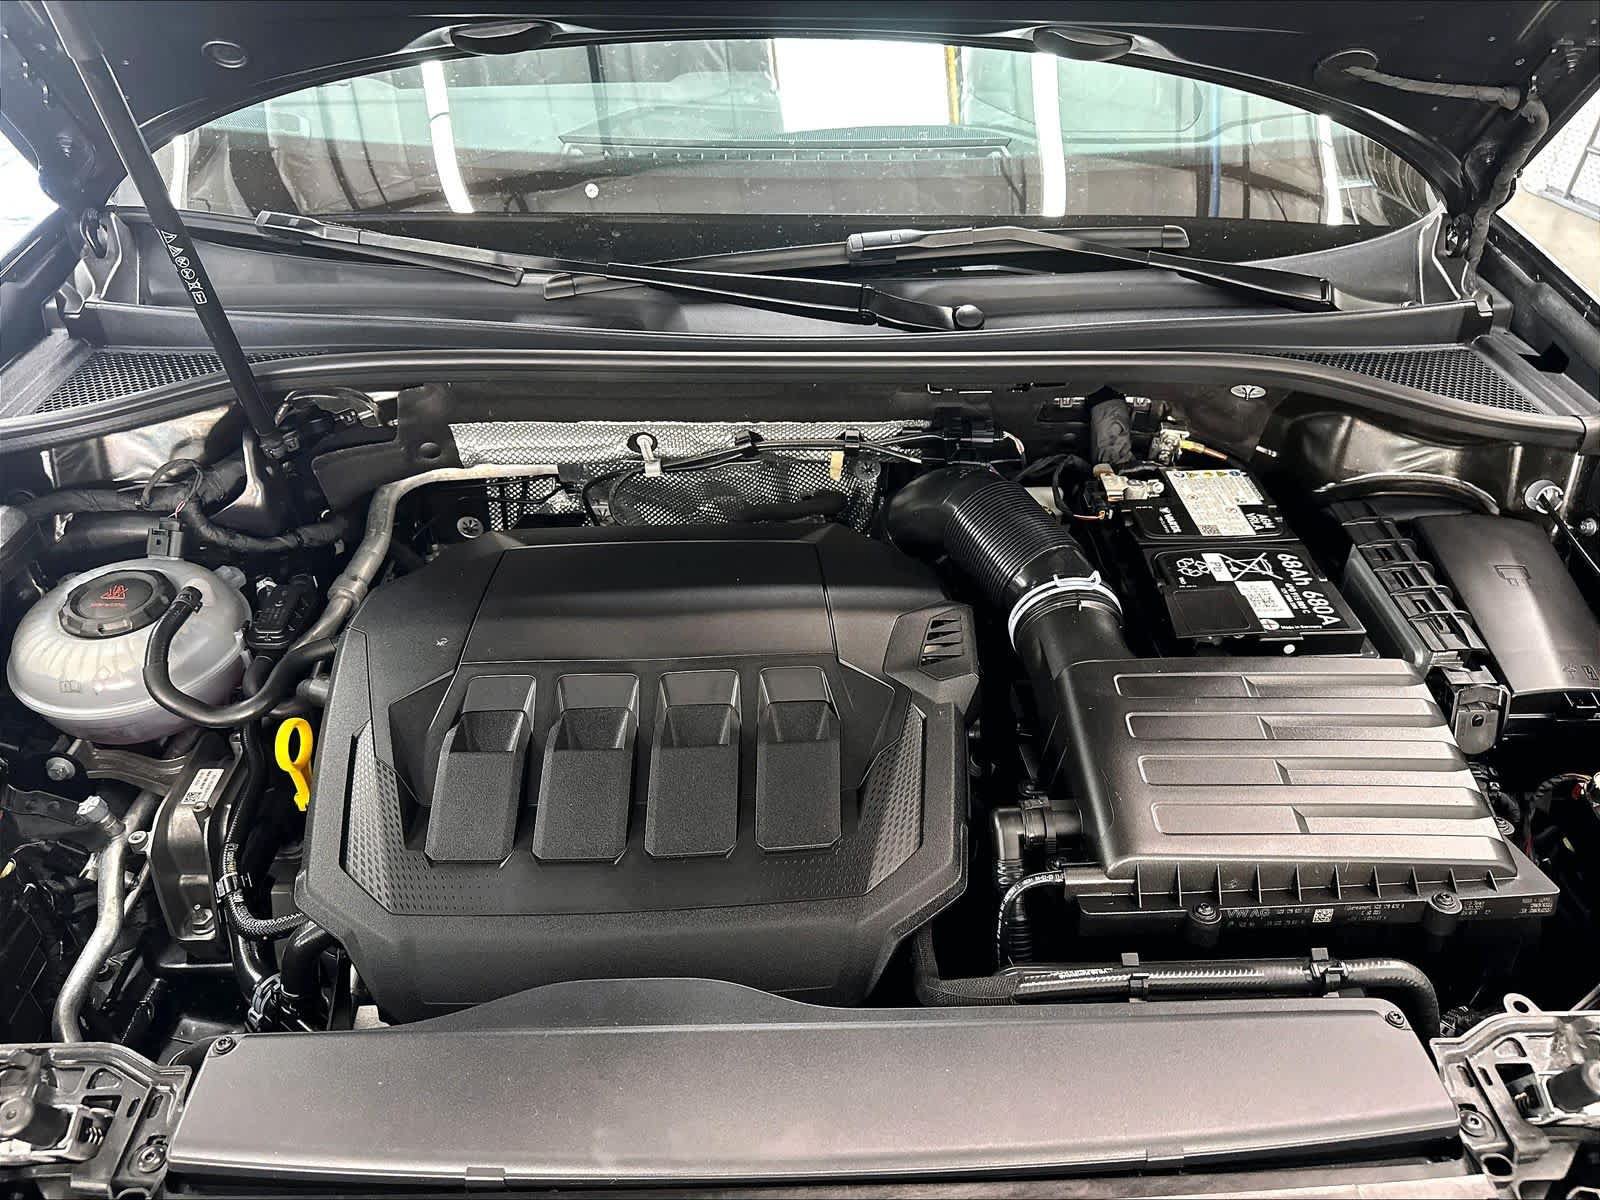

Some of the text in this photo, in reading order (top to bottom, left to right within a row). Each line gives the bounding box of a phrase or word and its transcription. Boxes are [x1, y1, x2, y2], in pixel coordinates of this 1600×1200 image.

[1245, 512, 1265, 530] VRLA
[1256, 513, 1276, 529] AGM
[1277, 553, 1313, 586] 68Ah
[1302, 590, 1341, 626] 680A
